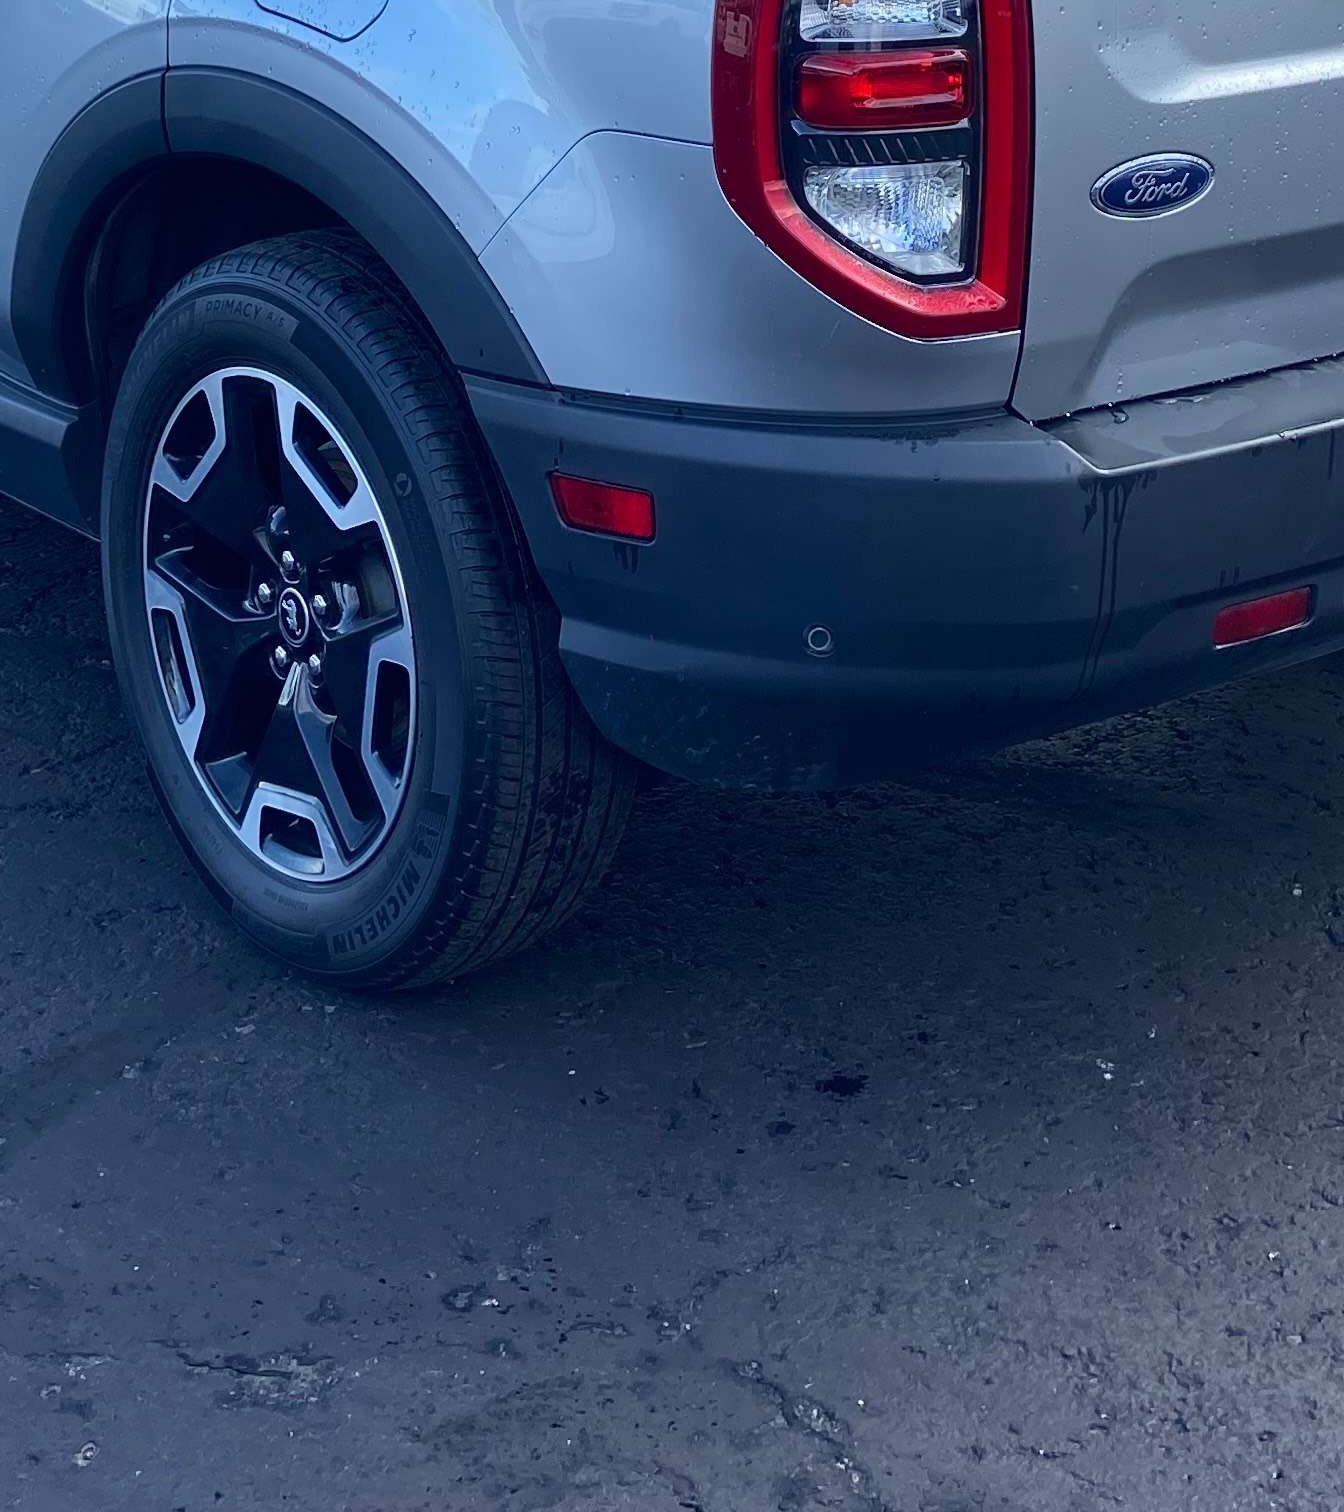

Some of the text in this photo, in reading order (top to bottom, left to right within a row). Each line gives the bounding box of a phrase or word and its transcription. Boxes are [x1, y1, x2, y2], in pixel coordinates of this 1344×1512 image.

[1124, 167, 1190, 205] Ford
[205, 299, 263, 320] PRIMACY
[332, 859, 422, 954] MICHELIN
